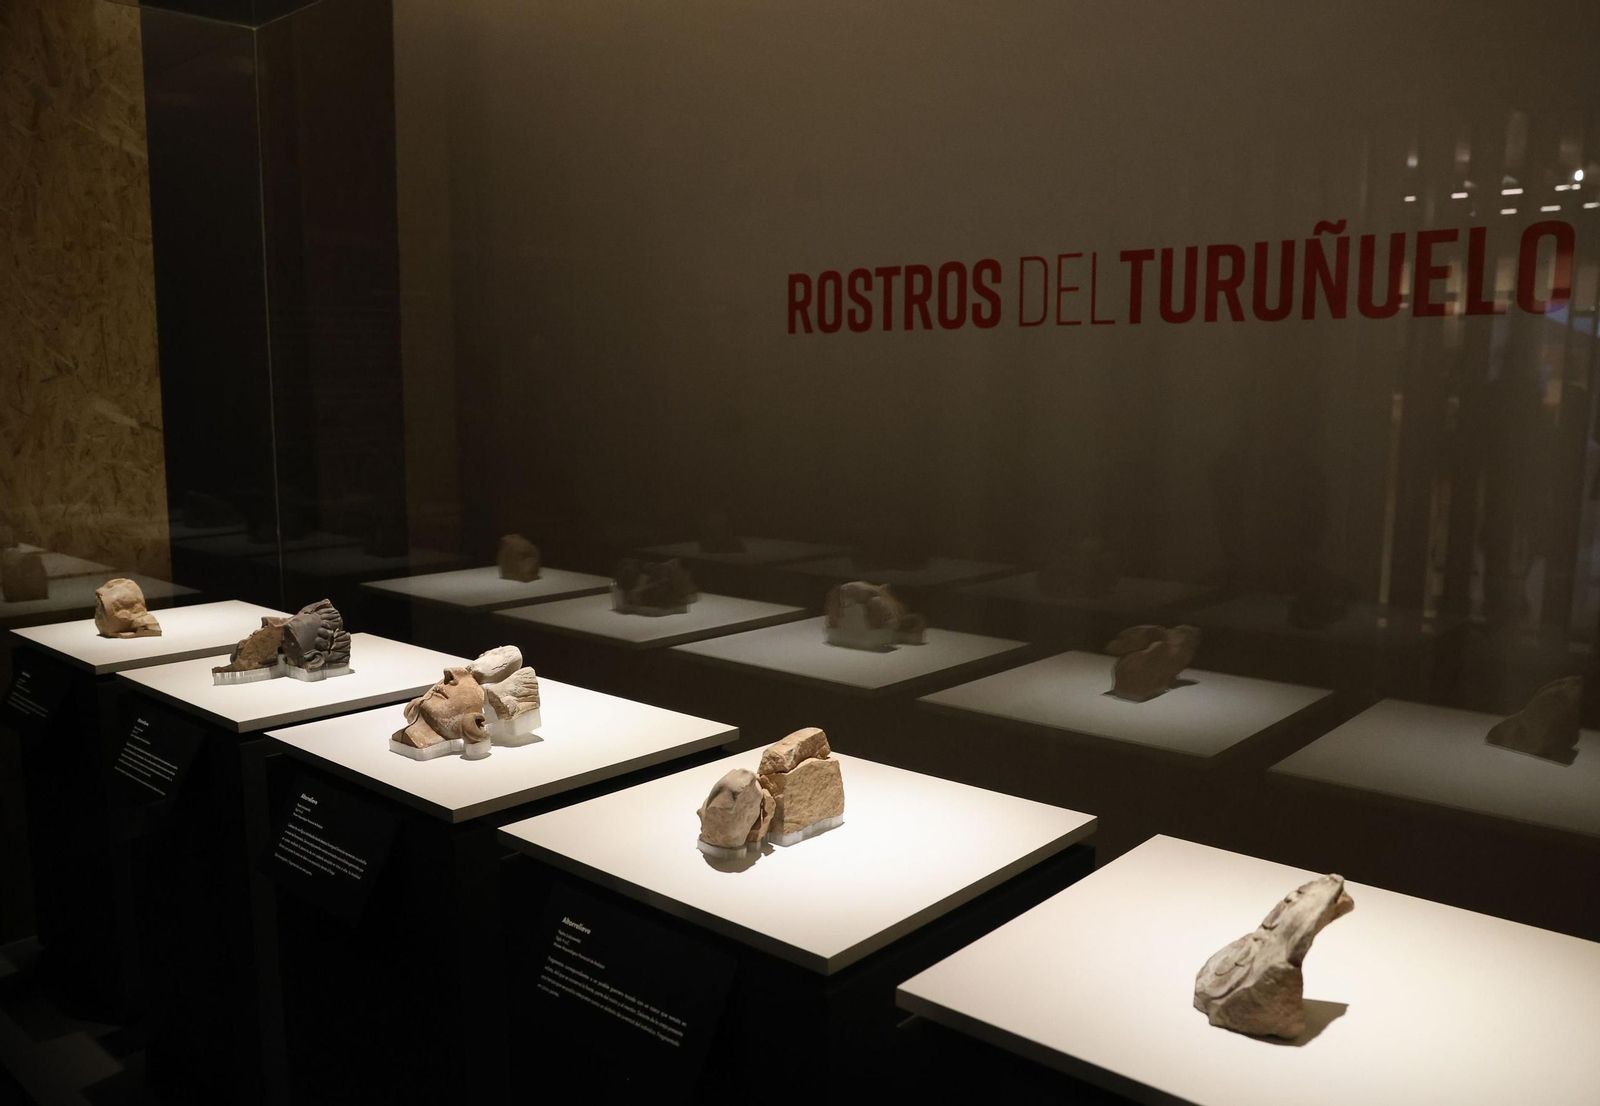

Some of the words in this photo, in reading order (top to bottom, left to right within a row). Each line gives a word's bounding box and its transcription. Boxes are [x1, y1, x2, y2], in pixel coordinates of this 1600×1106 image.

[788, 258, 1003, 335] ROSTROS
[1019, 252, 1115, 328] DEL
[1120, 219, 1576, 326] TURUÑUELO
